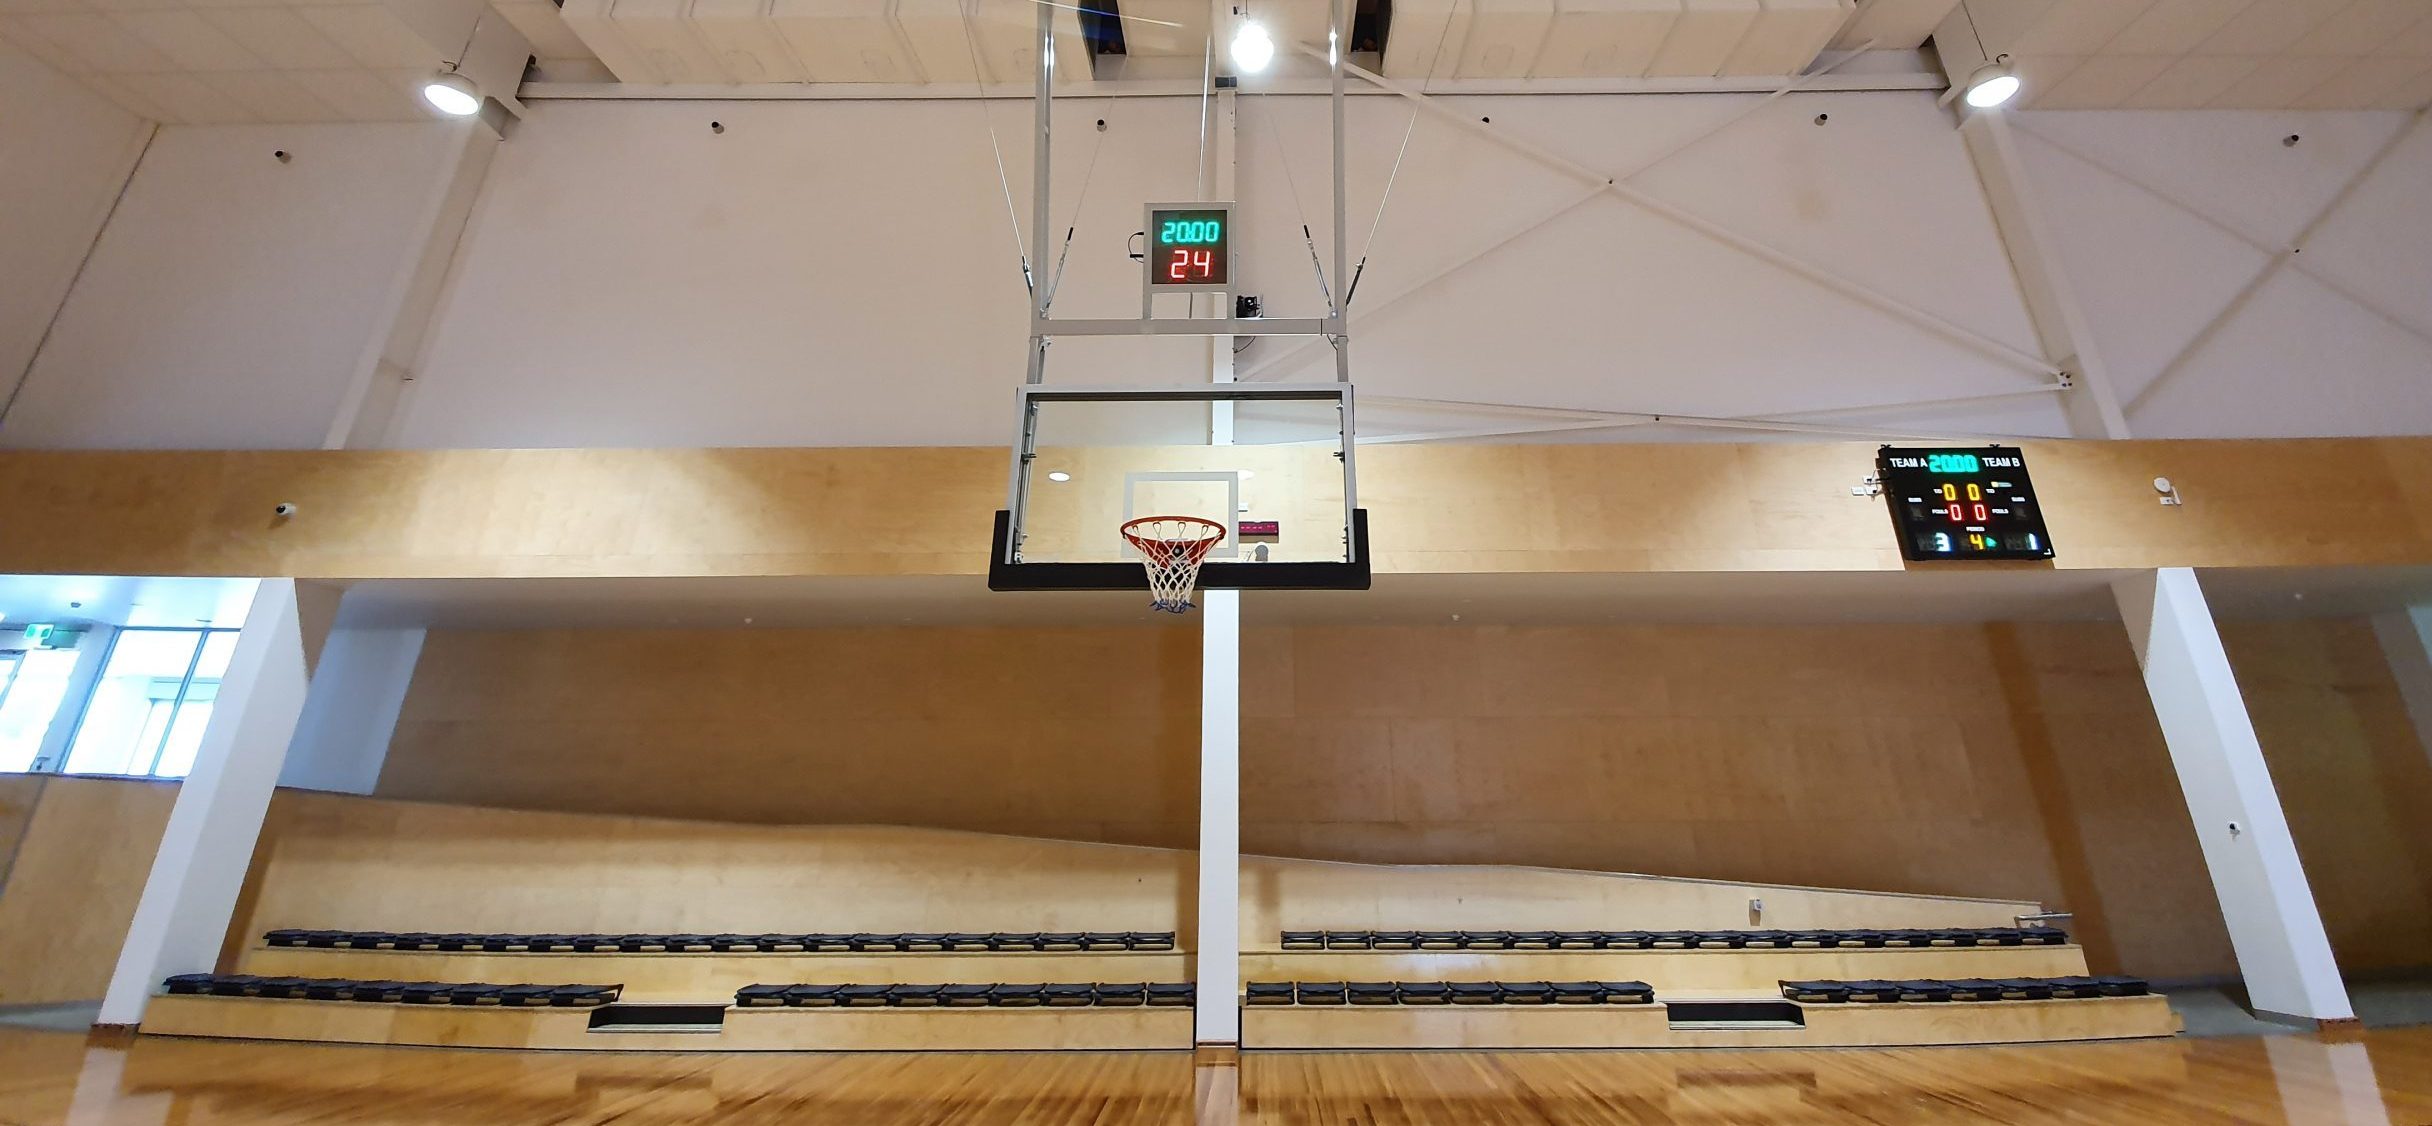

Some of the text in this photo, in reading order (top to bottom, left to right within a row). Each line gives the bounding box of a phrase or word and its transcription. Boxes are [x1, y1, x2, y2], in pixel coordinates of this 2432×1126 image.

[1170, 249, 1211, 278] 24
[1890, 458, 1928, 468] TEAM A
[1982, 457, 2021, 467] TEAM B
[1942, 483, 1956, 501] 0
[1966, 483, 1980, 501] 0
[1950, 504, 1962, 521] 0
[1974, 504, 1987, 521] 0
[1935, 532, 1951, 552] 3
[1969, 533, 1984, 550] 4
[2027, 532, 2039, 551] 1
